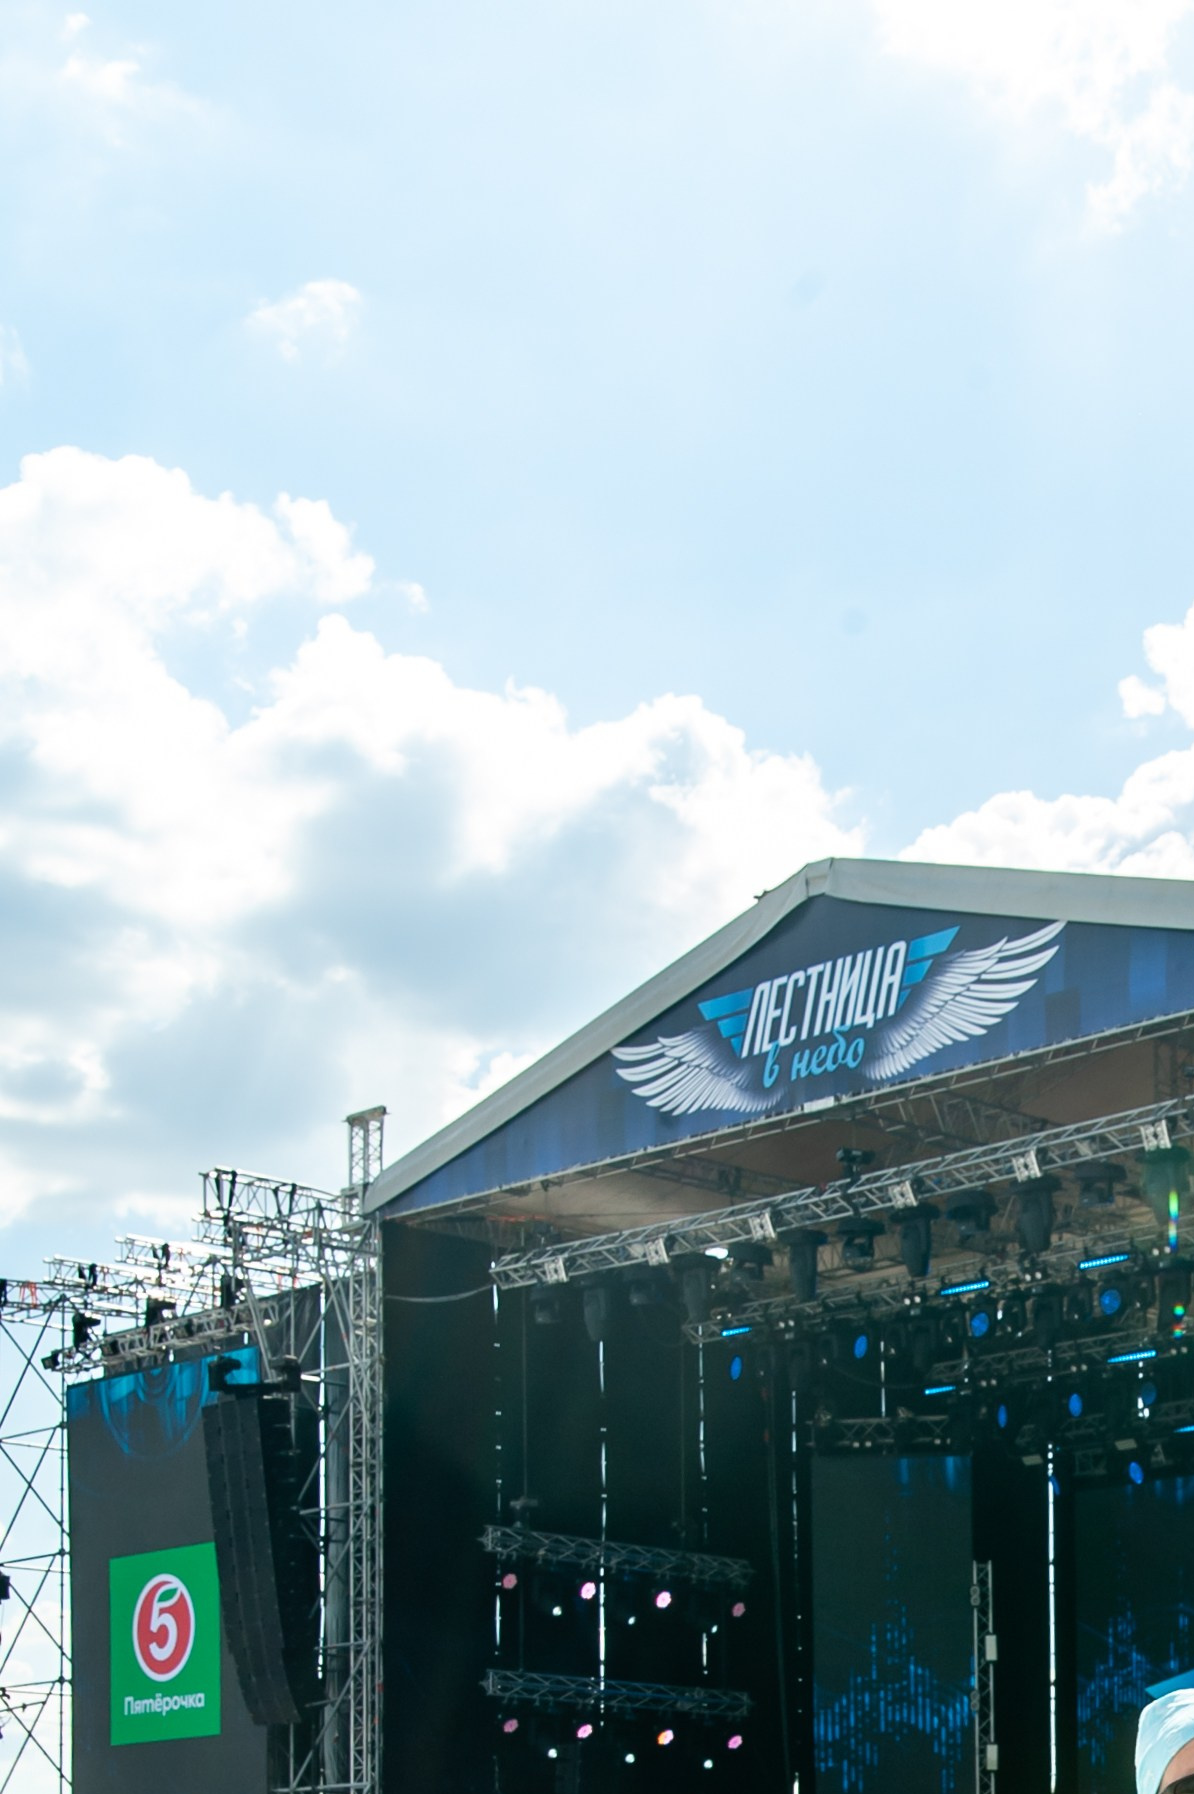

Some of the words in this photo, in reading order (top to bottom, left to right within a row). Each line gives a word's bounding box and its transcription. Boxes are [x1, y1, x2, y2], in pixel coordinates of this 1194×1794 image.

[741, 940, 907, 1059] ЛЕСТНИЦА
[763, 1040, 780, 1089] в
[790, 1025, 865, 1081] небо
[123, 1692, 206, 1717] Пятёрочка
